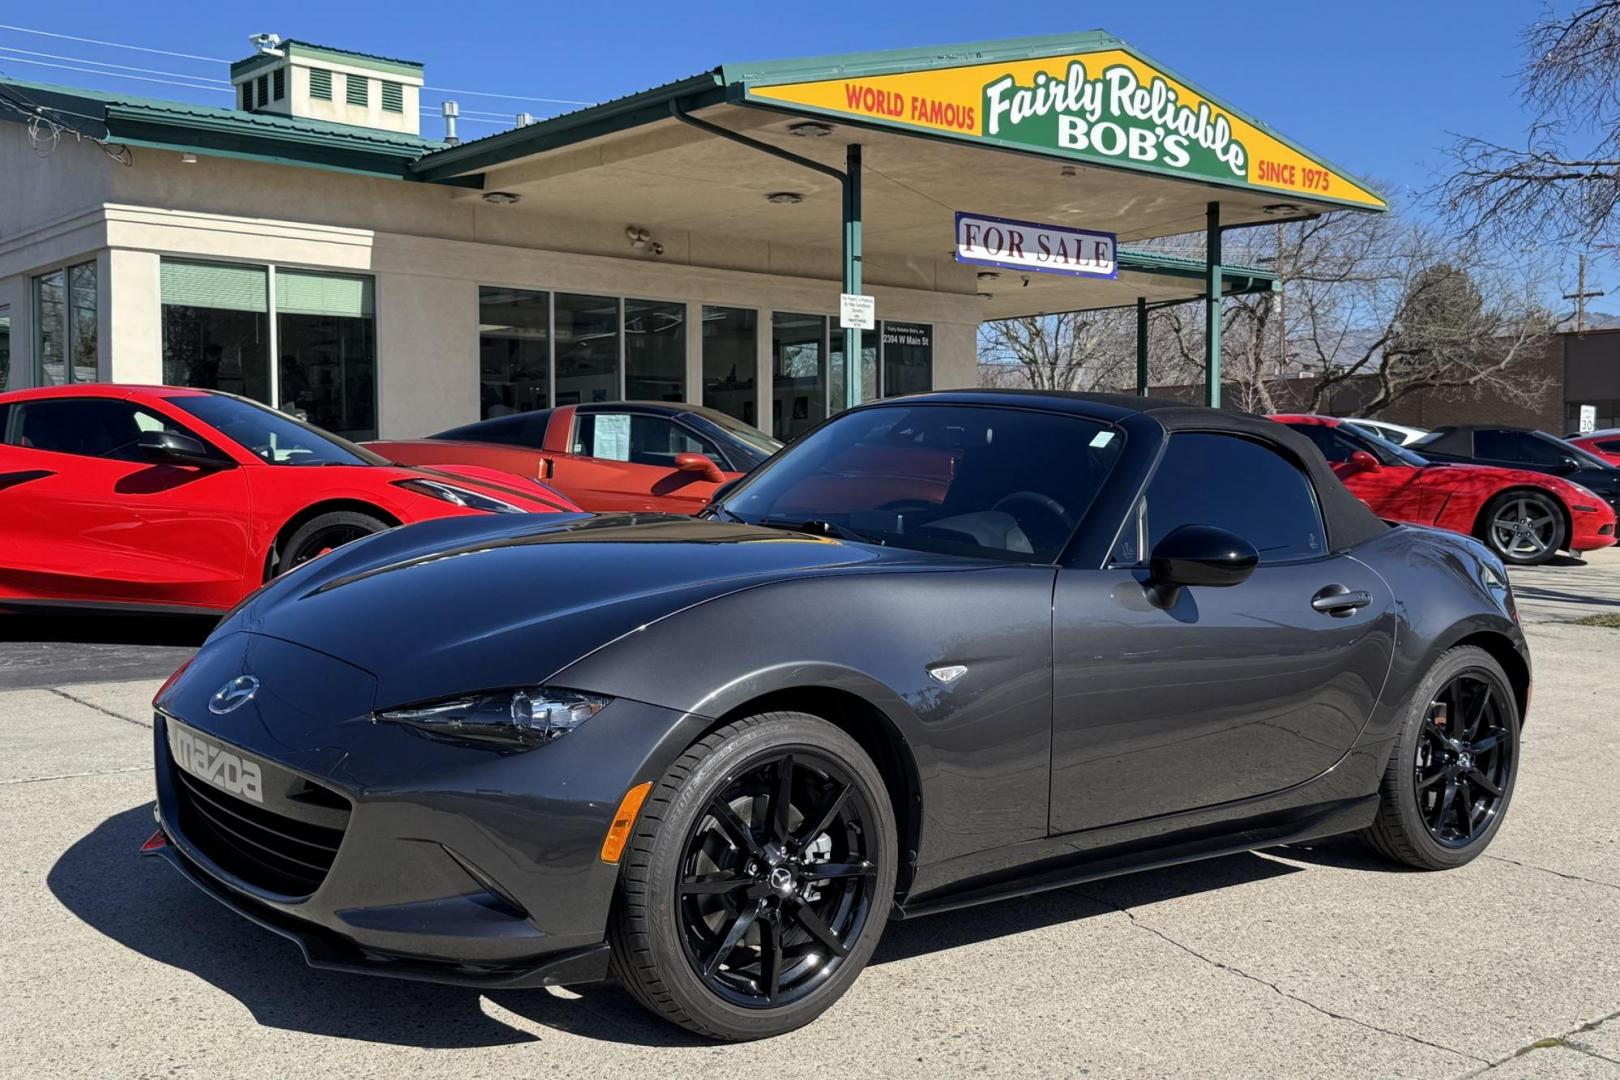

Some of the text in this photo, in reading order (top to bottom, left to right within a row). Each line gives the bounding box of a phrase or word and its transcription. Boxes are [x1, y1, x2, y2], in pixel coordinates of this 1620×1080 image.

[845, 83, 975, 130] WORLD FAMOUS
[987, 63, 1246, 176] Fairly Reliable
[1058, 114, 1191, 168] BOB'S
[1258, 160, 1329, 191] SINCE 1975
[963, 223, 1109, 269] FOR SALE
[899, 335, 906, 344] W
[906, 335, 921, 346] Main
[922, 336, 929, 346] St
[1582, 420, 1592, 430] 30
